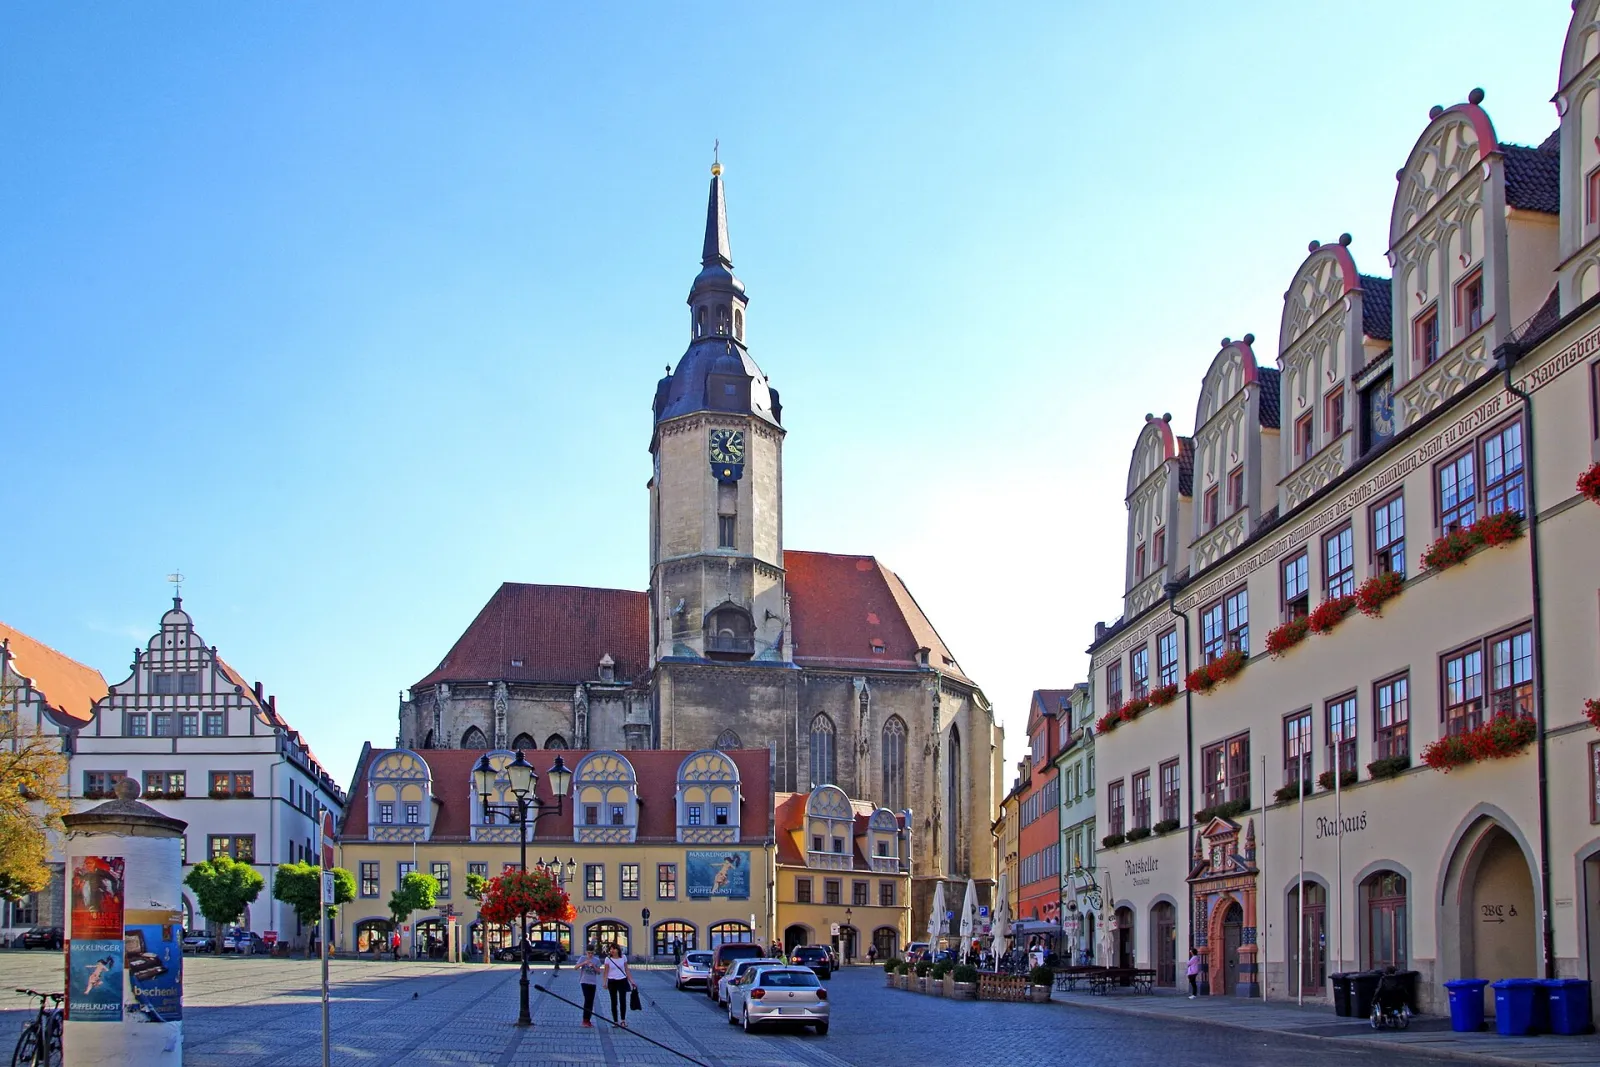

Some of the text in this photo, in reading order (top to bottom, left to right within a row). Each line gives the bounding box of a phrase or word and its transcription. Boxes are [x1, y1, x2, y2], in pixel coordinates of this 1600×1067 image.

[1444, 428, 1456, 446] zu
[1458, 416, 1474, 436] der
[1316, 810, 1367, 840] Rathaus
[1481, 904, 1504, 916] WC
[71, 944, 120, 952] MAX KLINGER
[69, 1003, 120, 1011] GRIFFELKUNST
